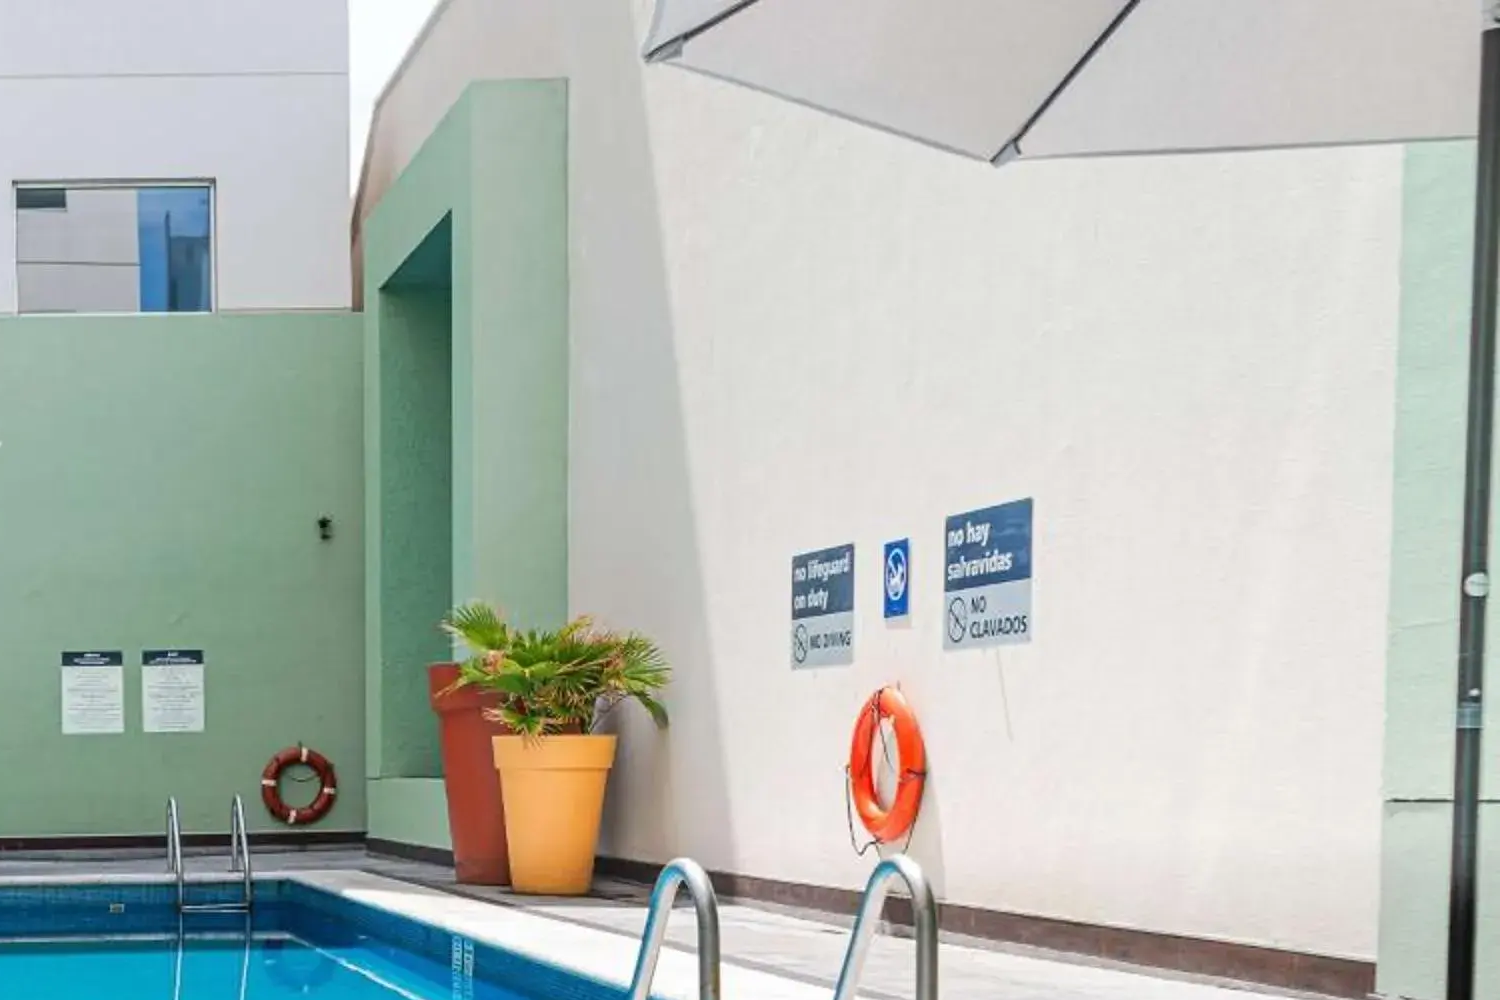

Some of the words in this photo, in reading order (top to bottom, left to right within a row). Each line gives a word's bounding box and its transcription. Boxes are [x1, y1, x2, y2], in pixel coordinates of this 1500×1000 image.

[947, 528, 965, 548] no
[965, 521, 991, 547] hay
[947, 549, 1013, 581] salvavidas
[970, 594, 987, 614] NO
[970, 615, 1028, 639] CLAVADOS
